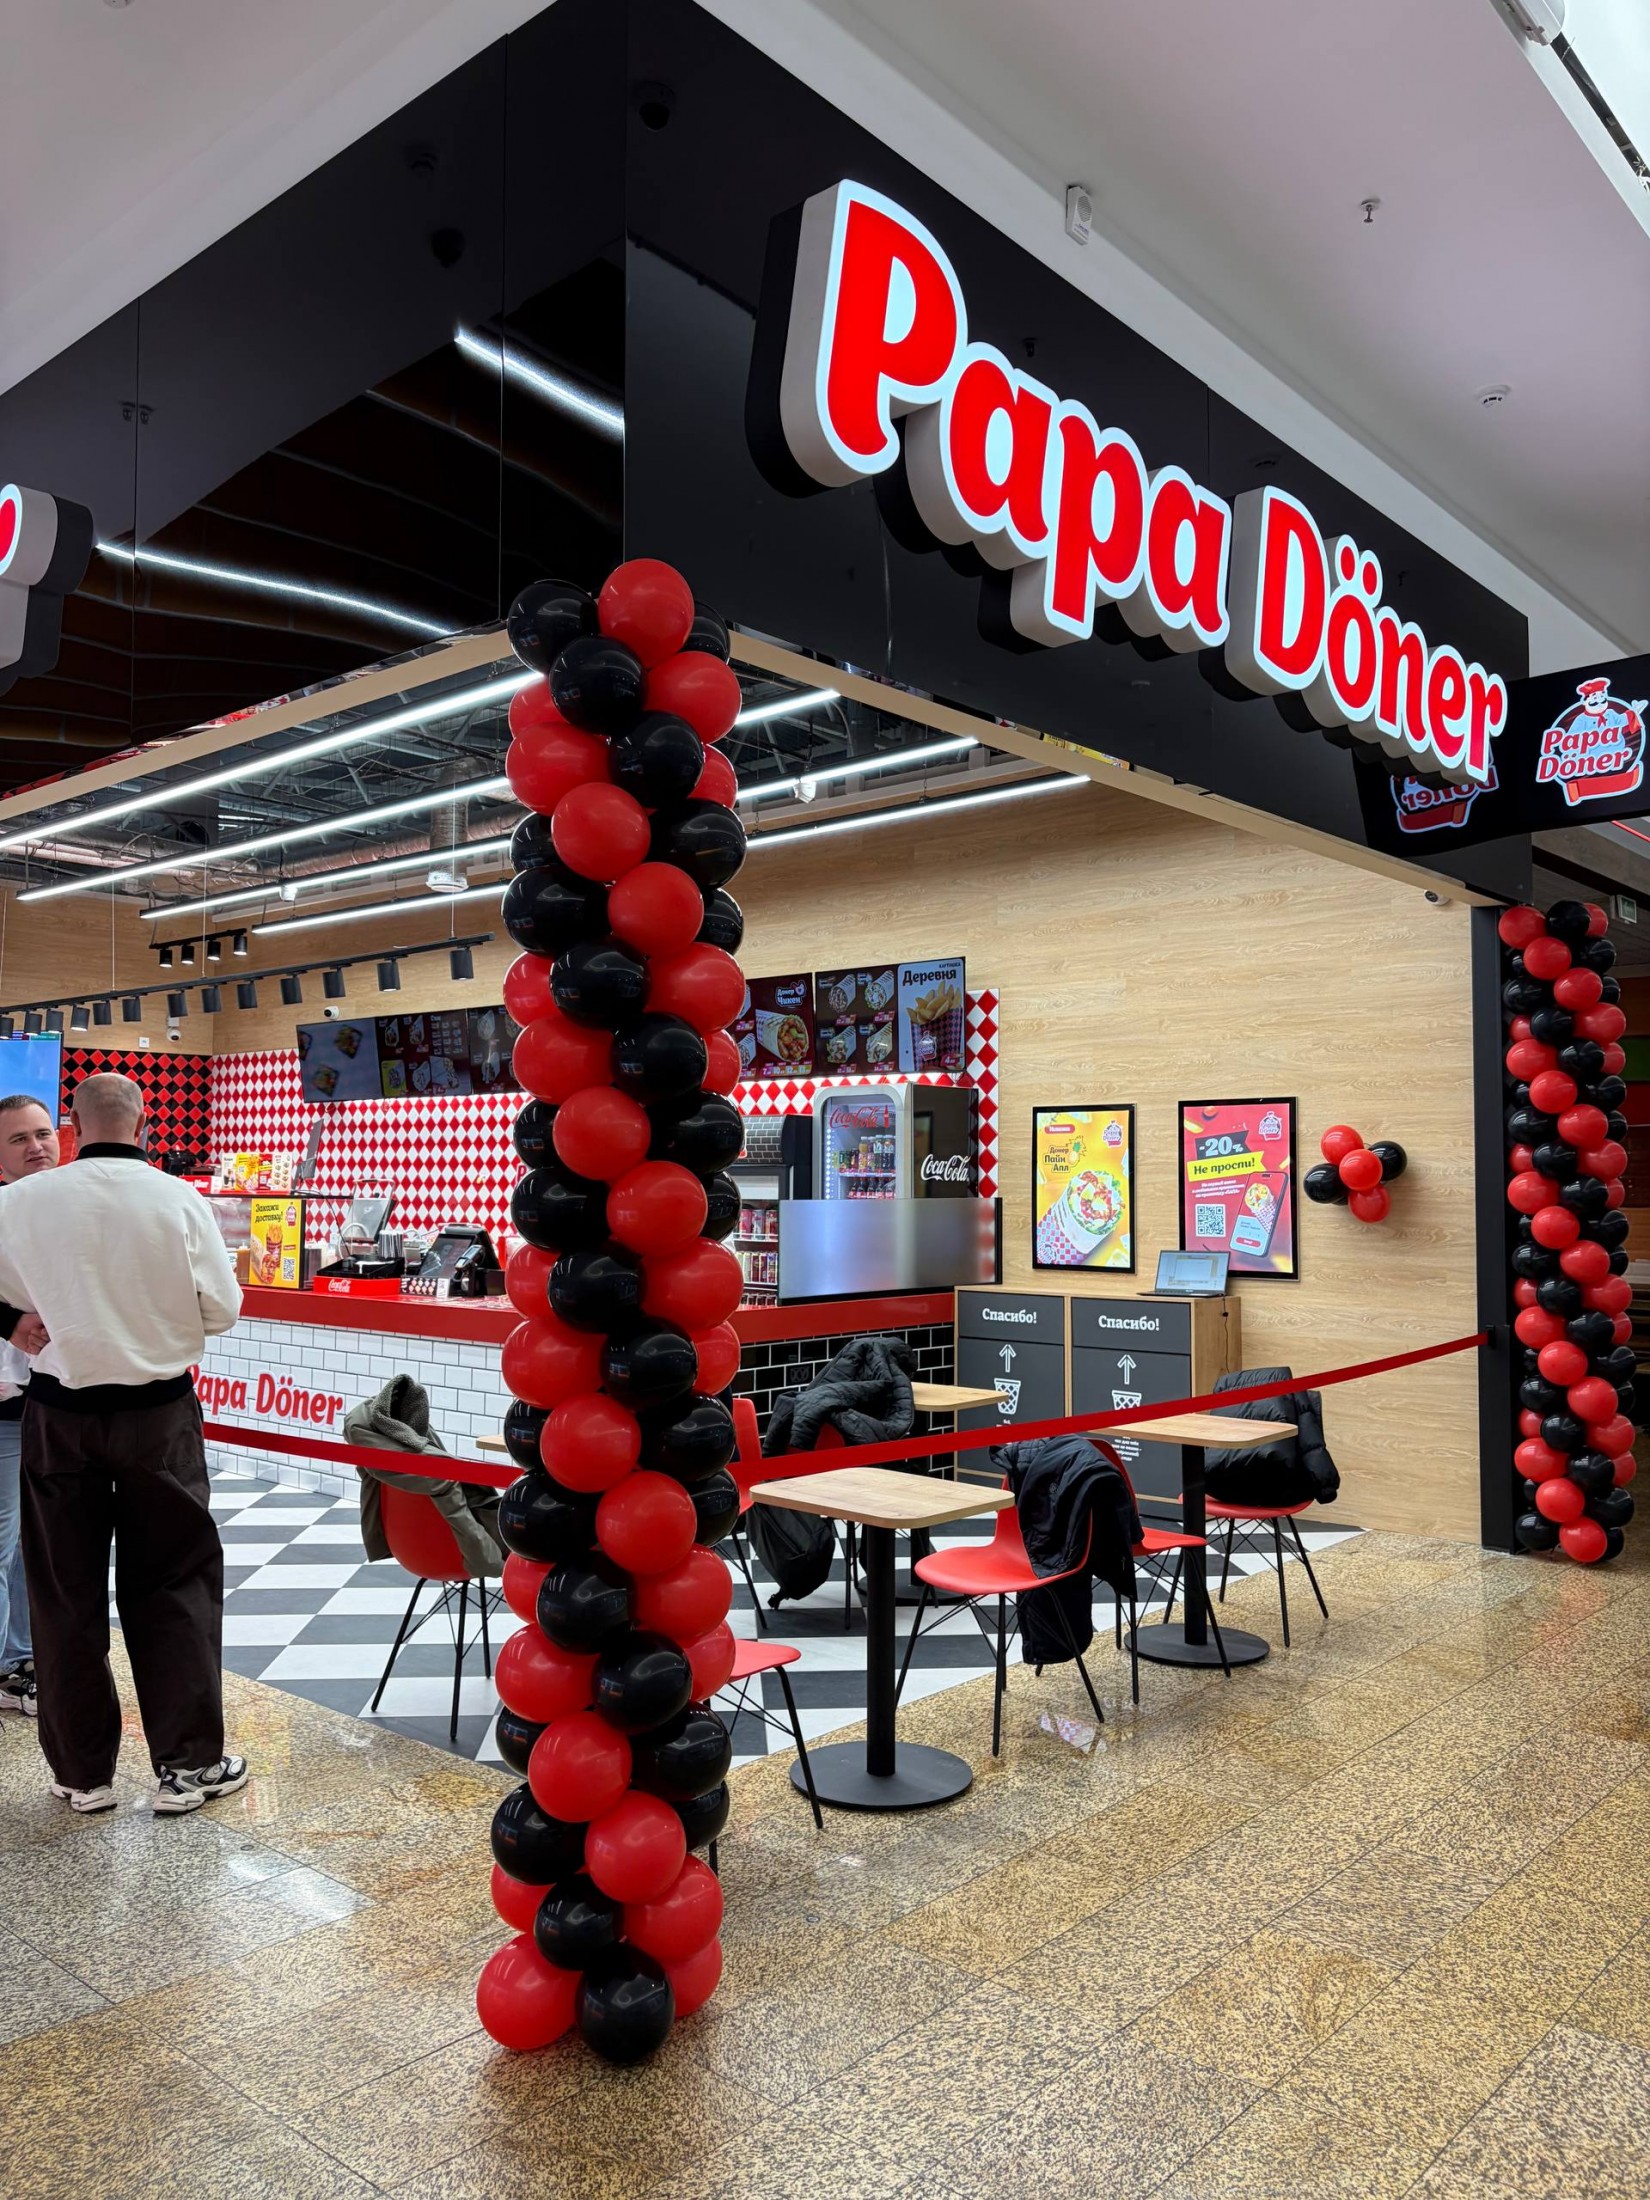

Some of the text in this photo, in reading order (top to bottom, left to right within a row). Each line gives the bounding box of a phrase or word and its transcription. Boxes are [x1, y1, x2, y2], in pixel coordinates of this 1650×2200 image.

[820, 185, 1506, 776] Papa Döner
[1543, 724, 1619, 754] Papa
[1538, 748, 1630, 780] Döner
[902, 968, 957, 987] Деревня
[921, 1153, 970, 1182] Coca-Cola
[1044, 1155, 1066, 1163] Пайн
[1194, 1157, 1255, 1175] Не проспи!
[255, 1203, 279, 1213] Закажи
[255, 1211, 283, 1224] доставку!
[982, 1307, 1037, 1324] Спасибо!
[1098, 1315, 1160, 1331] Спасибо!
[256, 1373, 343, 1425] Döner
